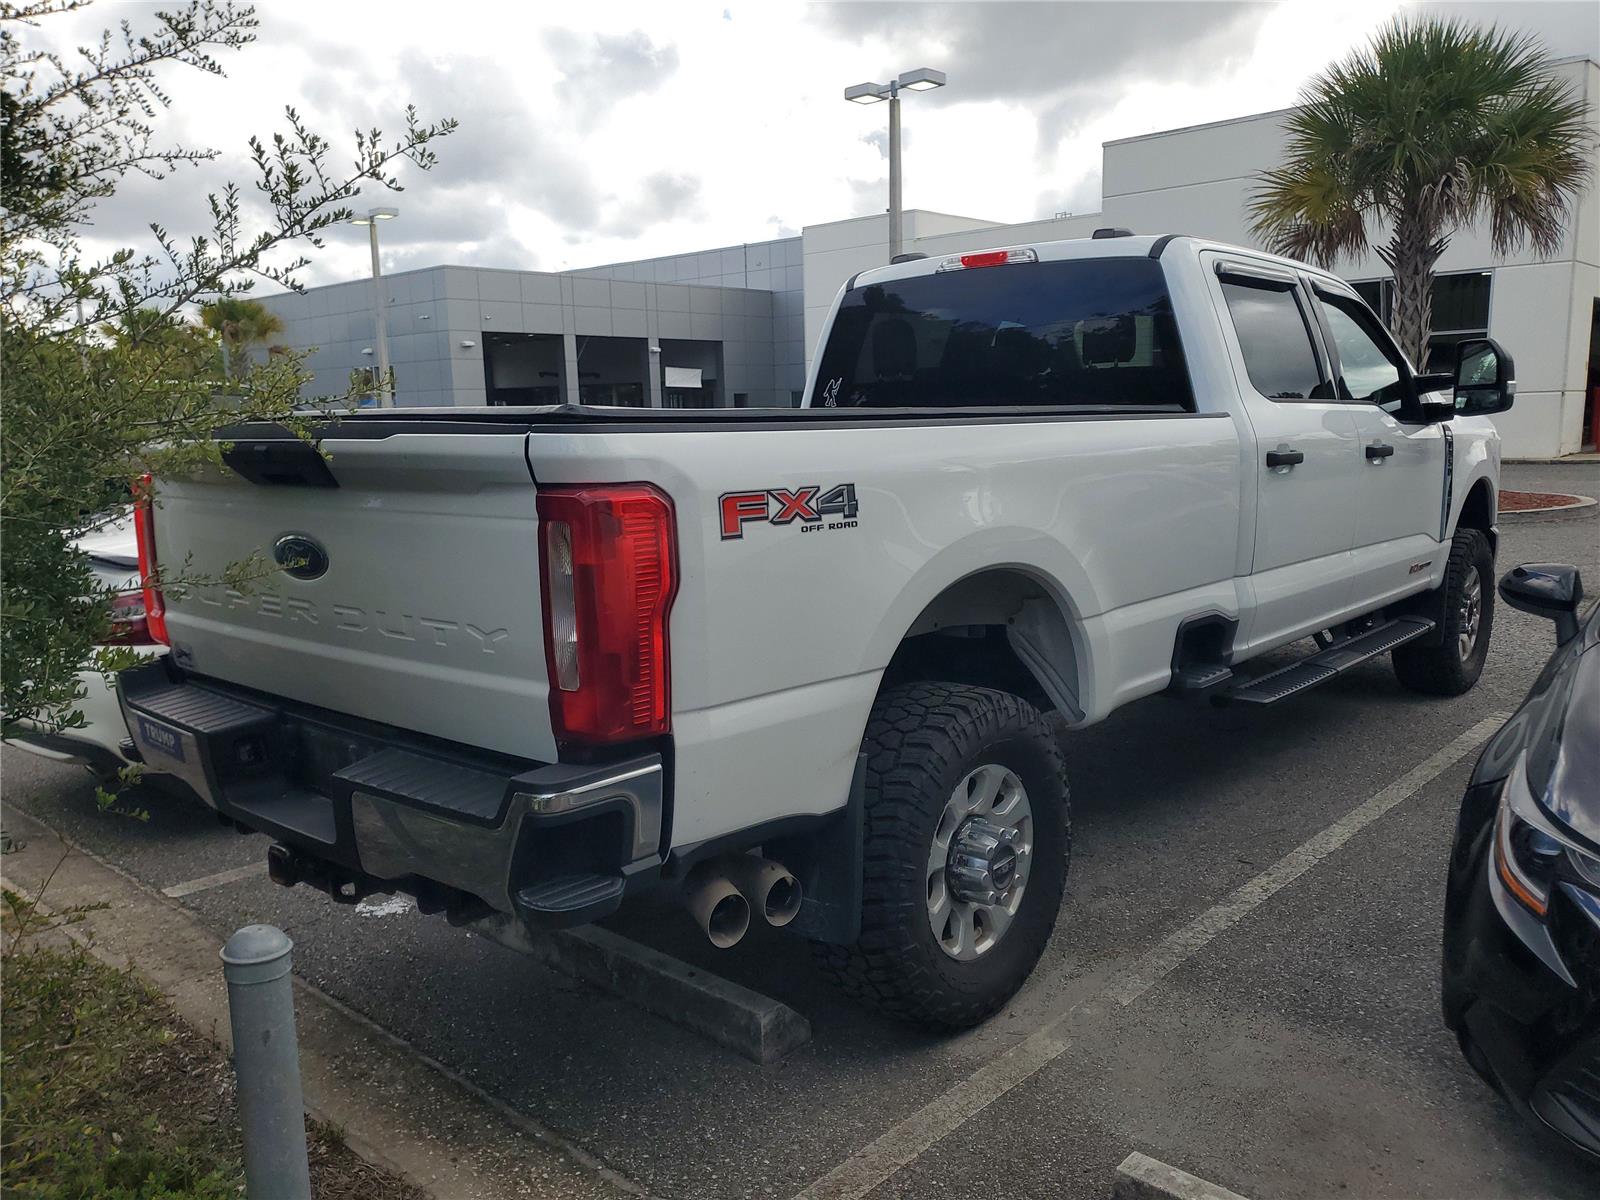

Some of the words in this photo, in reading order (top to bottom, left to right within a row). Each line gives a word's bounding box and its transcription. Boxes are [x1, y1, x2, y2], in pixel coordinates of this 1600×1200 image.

[718, 483, 859, 541] FX4
[801, 524, 825, 533] OFF
[828, 520, 858, 531] ROAD
[333, 604, 509, 654] DUTY
[143, 722, 176, 748] TRUMP
